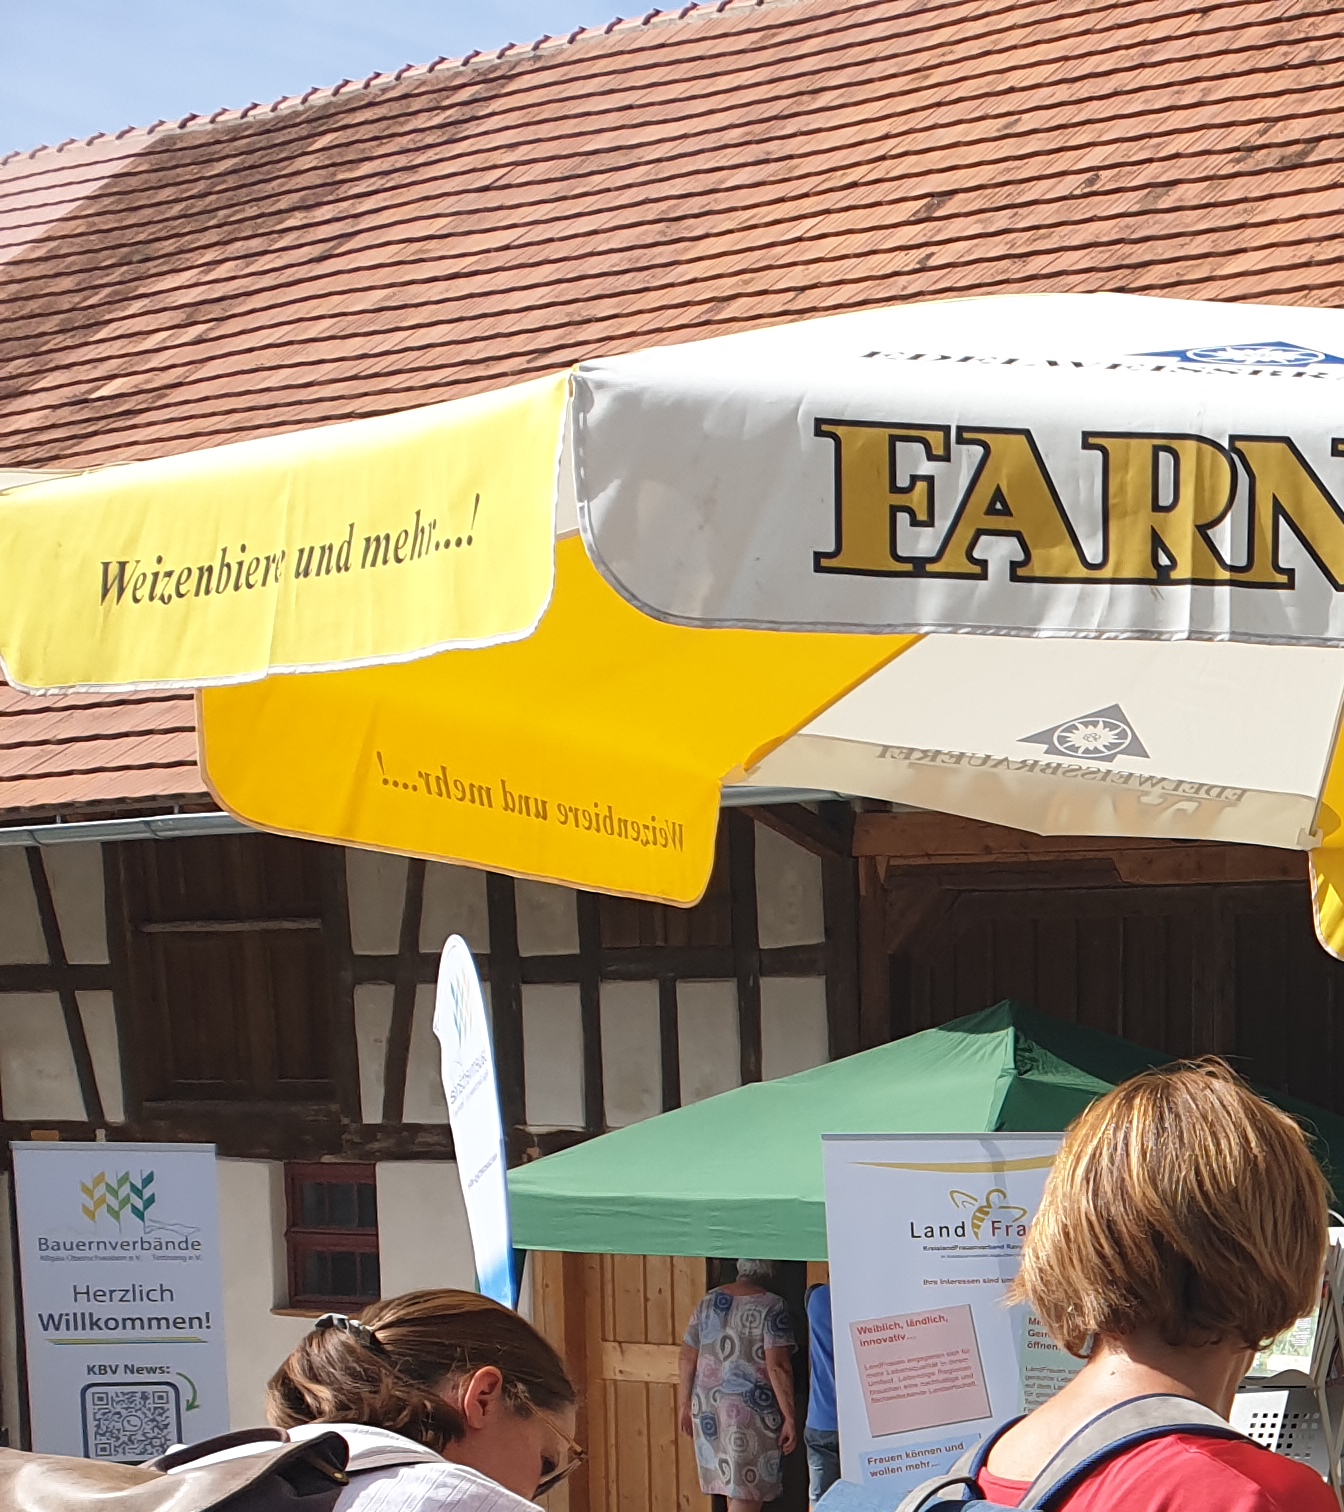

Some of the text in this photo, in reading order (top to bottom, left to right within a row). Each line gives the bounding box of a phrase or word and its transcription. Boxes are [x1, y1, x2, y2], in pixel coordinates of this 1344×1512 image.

[99, 492, 481, 607] Weizenbiere und mehr...!
[910, 1220, 1026, 1238] Land Fra
[38, 1236, 202, 1252] Bauernverbände
[72, 1283, 174, 1303] Herzlich
[38, 1311, 212, 1332] Willkommen!
[856, 1314, 949, 1336] Weiblich, ländlich,
[87, 1363, 171, 1375] KBV News:
[867, 1442, 964, 1465] Frauen können und
[869, 1464, 903, 1478] wollen
